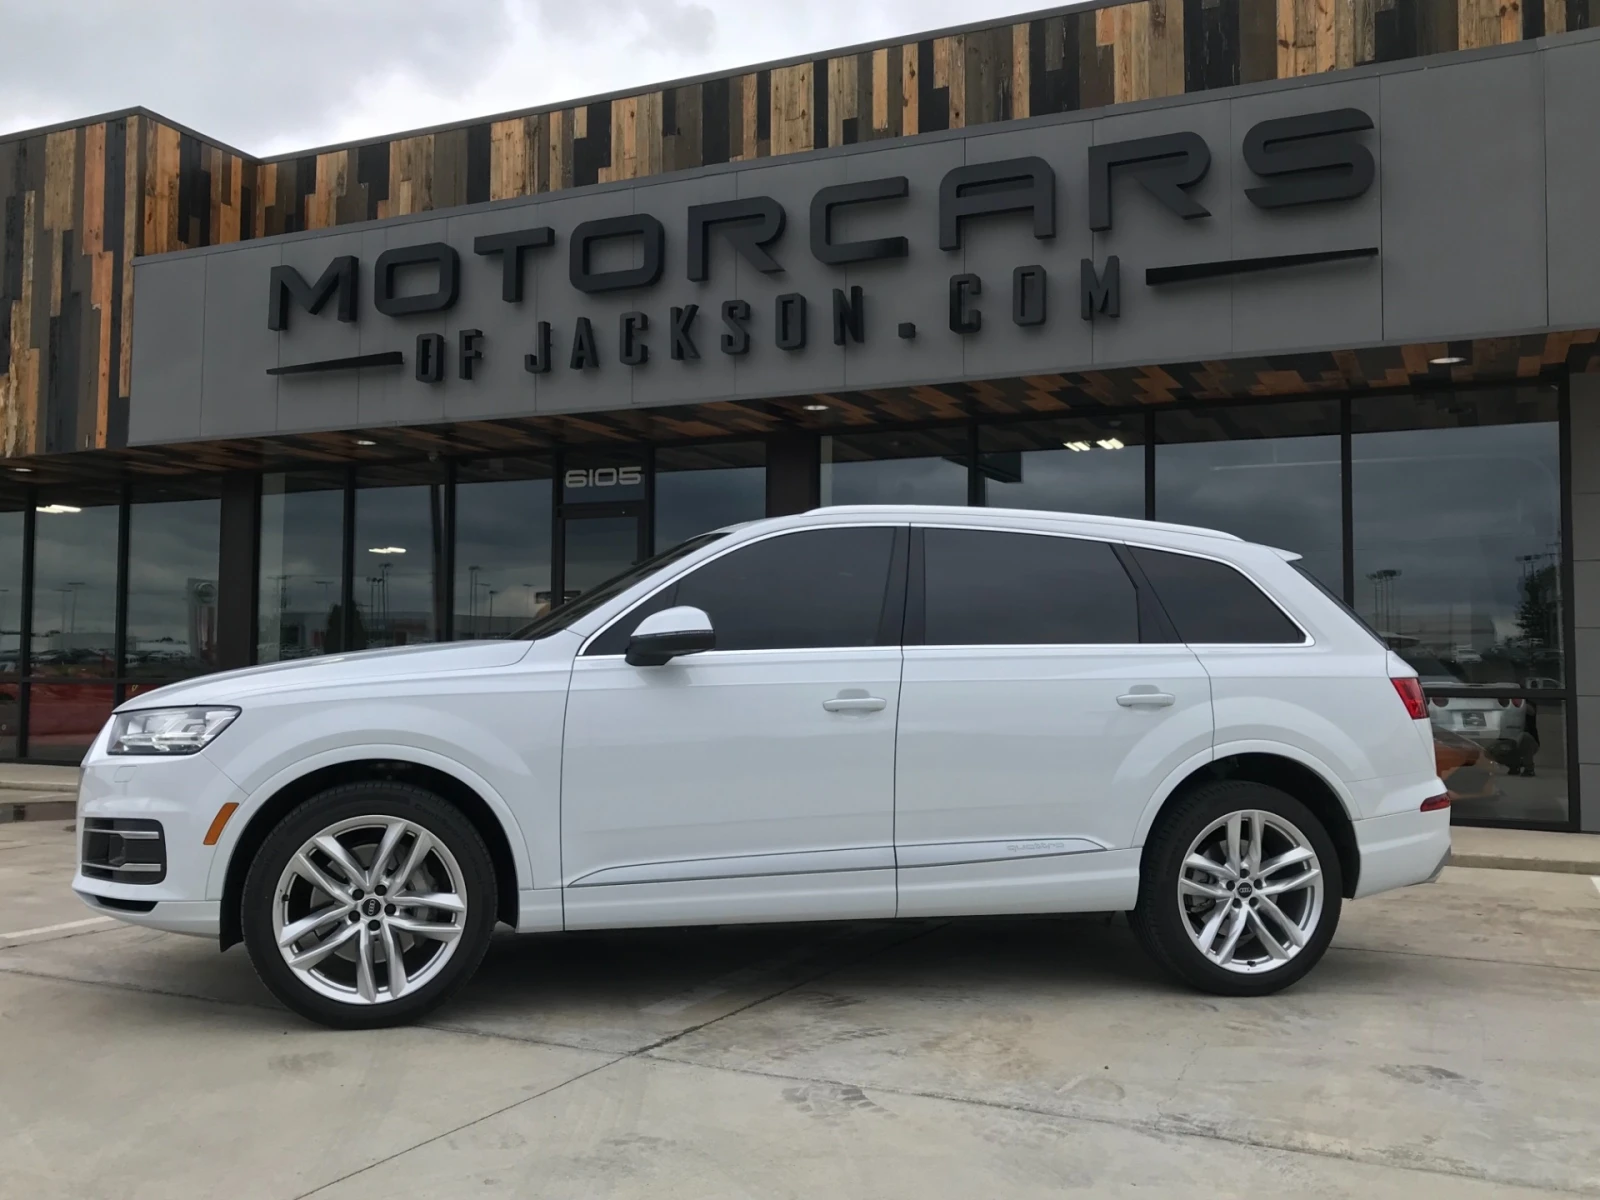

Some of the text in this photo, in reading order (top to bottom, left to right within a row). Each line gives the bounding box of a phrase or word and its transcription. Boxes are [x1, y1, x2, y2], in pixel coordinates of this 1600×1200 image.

[268, 108, 1376, 331] MOTORCARS
[416, 328, 483, 384] OF
[565, 466, 642, 488] 6105
